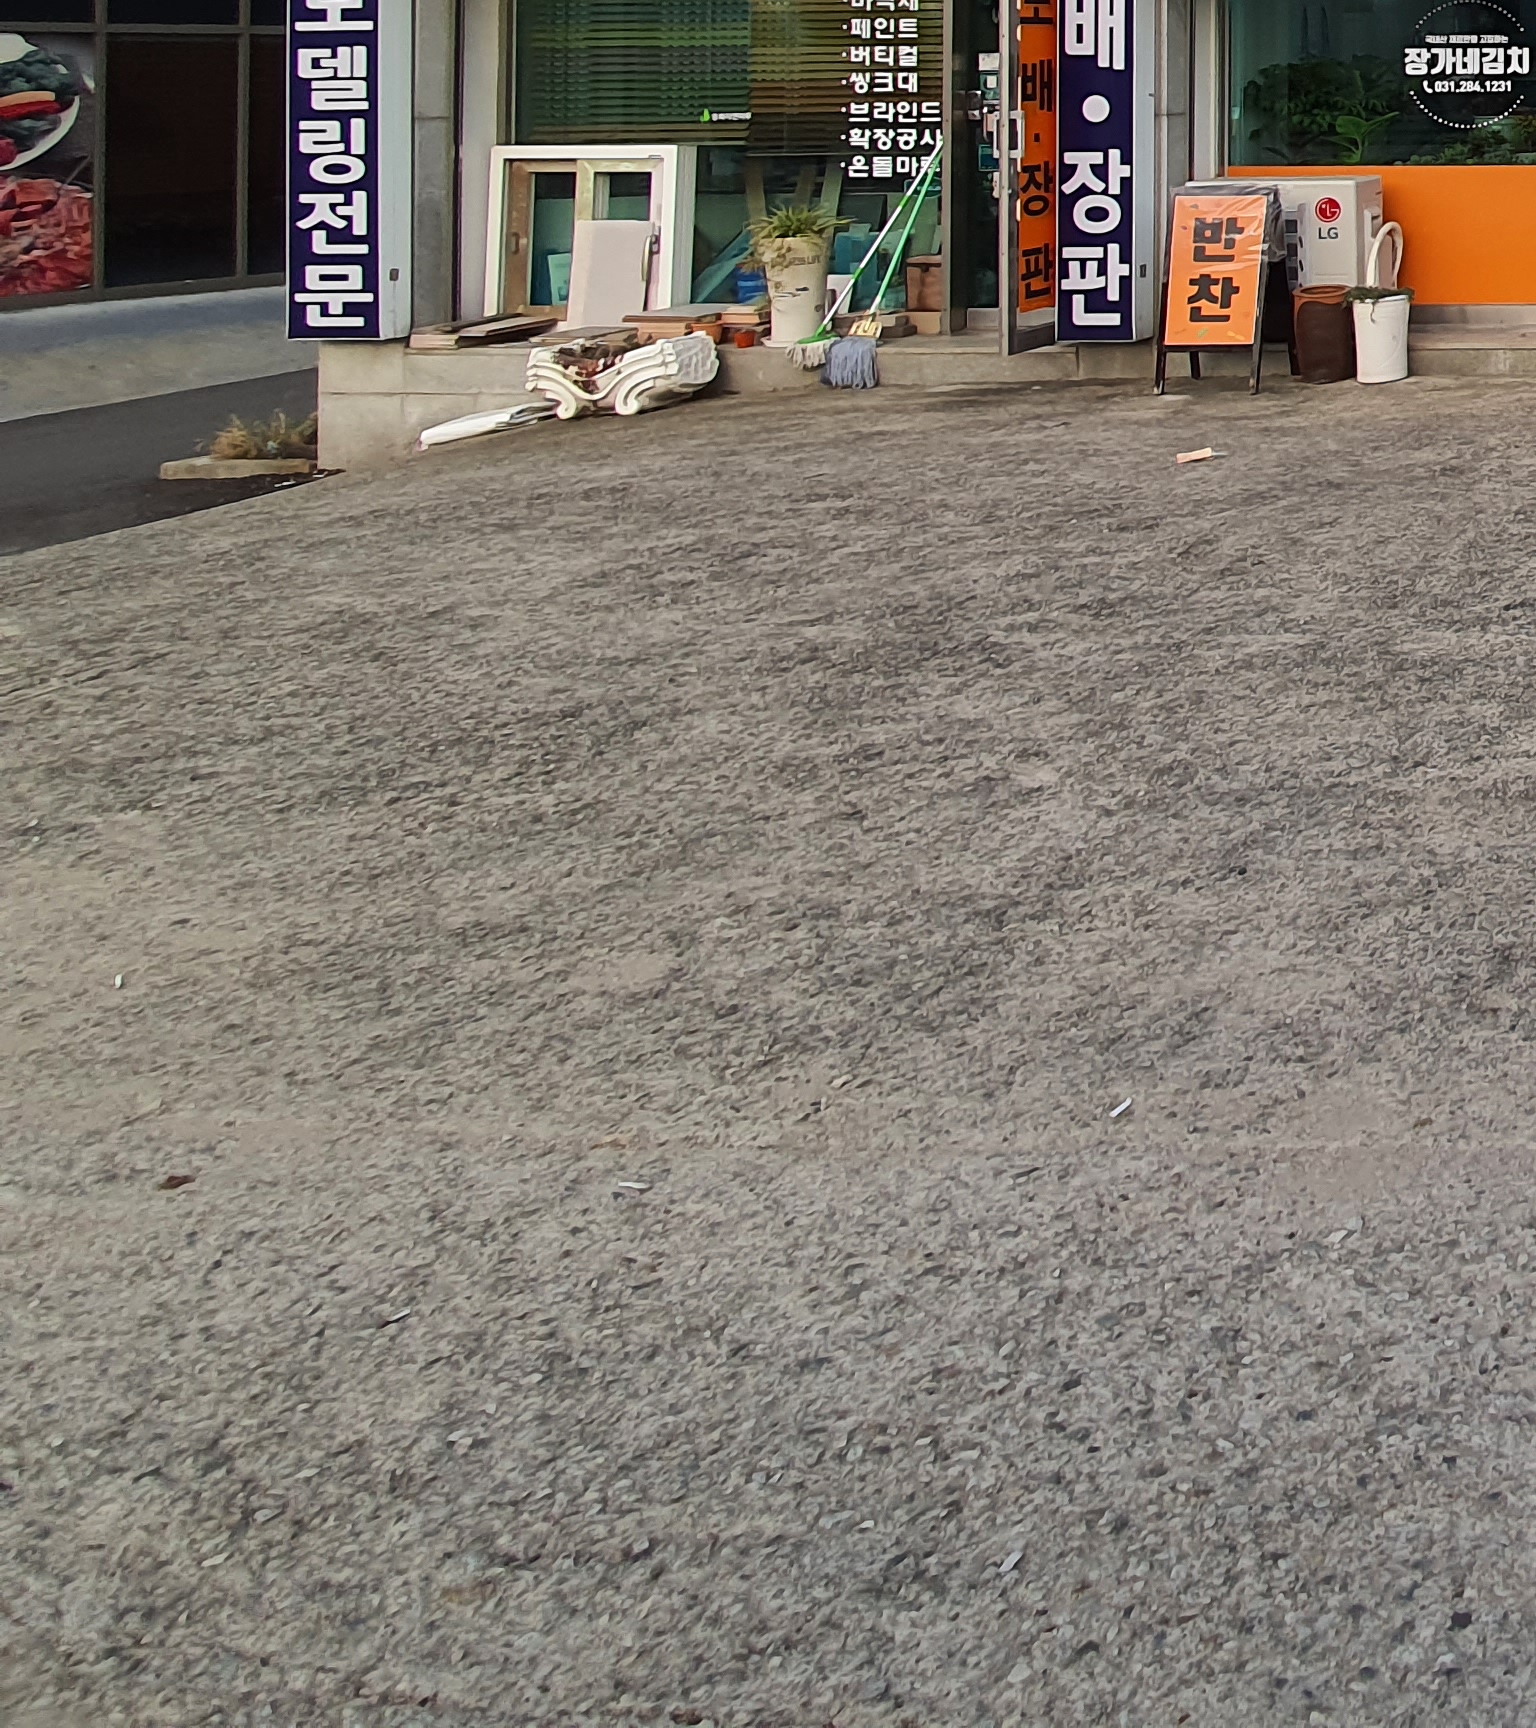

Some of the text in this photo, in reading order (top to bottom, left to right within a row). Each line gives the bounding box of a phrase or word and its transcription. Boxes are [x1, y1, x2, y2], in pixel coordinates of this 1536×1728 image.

[850, 18, 918, 39] 페인트
[850, 45, 918, 67] 버티컬
[1404, 46, 1530, 75] 장가네김치
[850, 72, 918, 93] 씽크대
[848, 101, 942, 122] 브라인드
[848, 128, 943, 150] 확장공사
[1318, 227, 1338, 240] LG
[1187, 217, 1245, 323] 반찬
